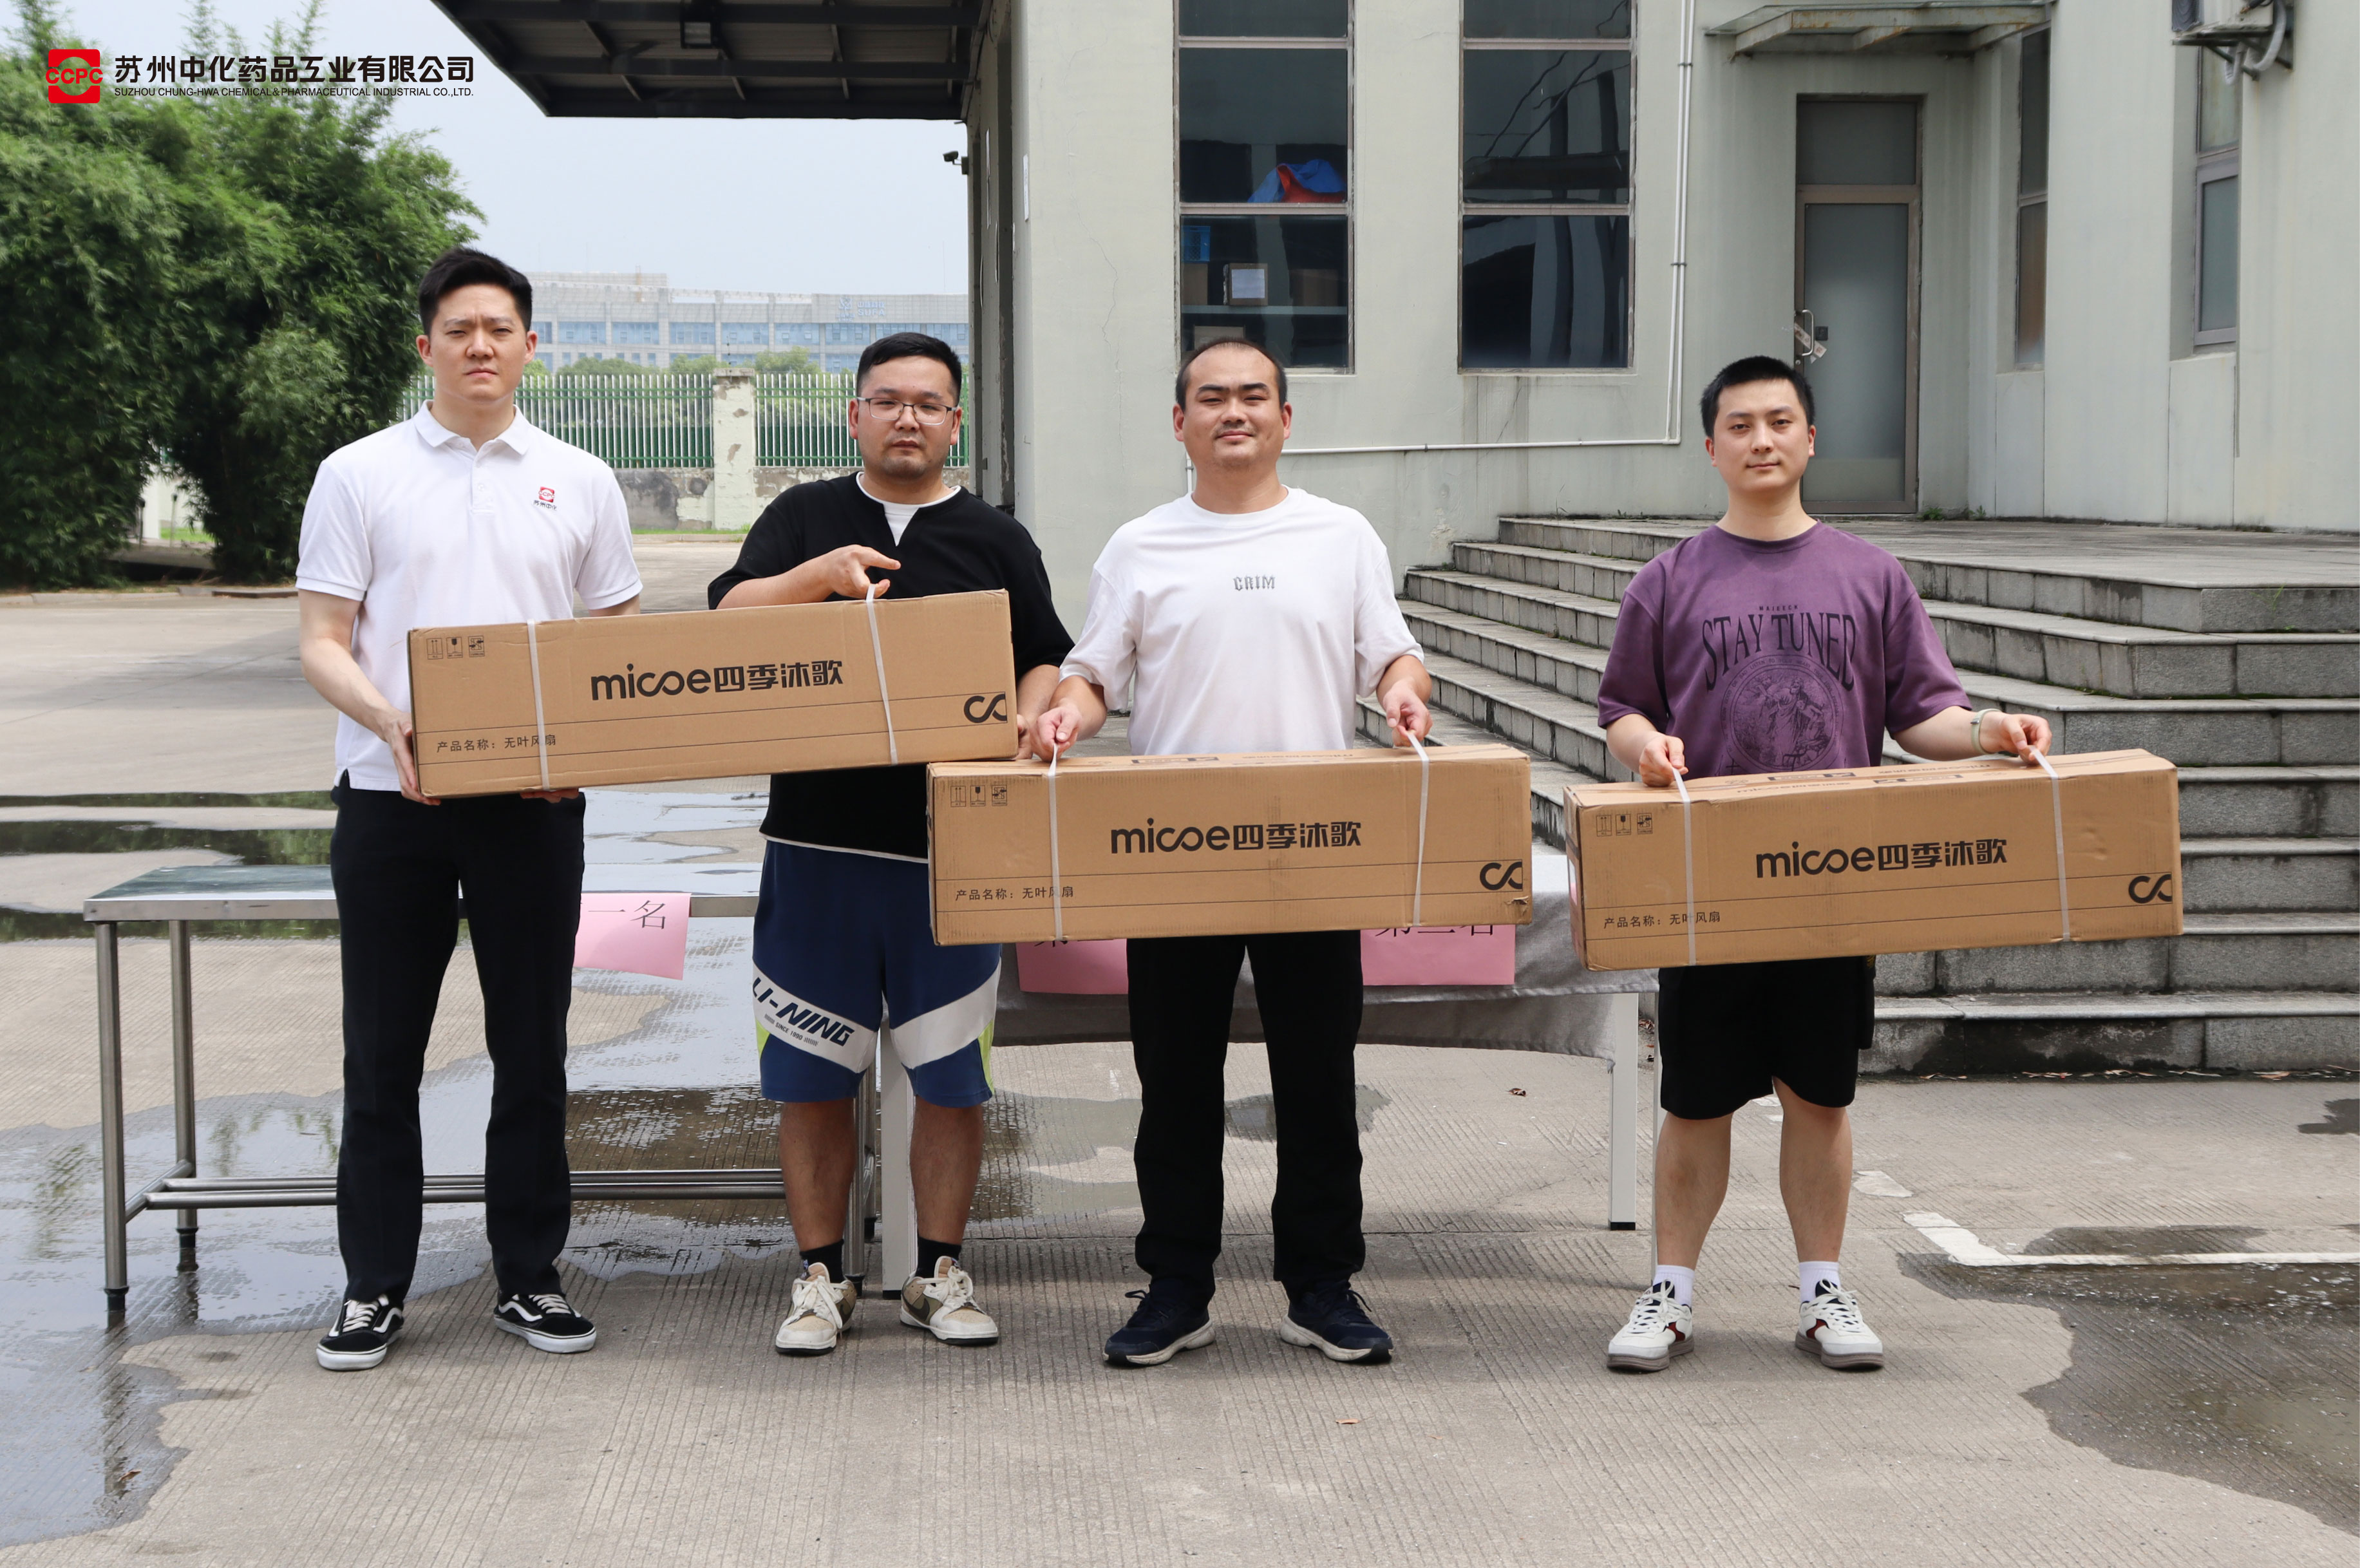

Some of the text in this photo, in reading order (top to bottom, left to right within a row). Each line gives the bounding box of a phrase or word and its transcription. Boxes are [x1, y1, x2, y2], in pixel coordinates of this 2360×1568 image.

[1702, 612, 1856, 692] STAY TUNED
[580, 900, 666, 929] 一名
[753, 977, 855, 1046] LI-NING
[775, 1023, 803, 1041] SINCE 1990
